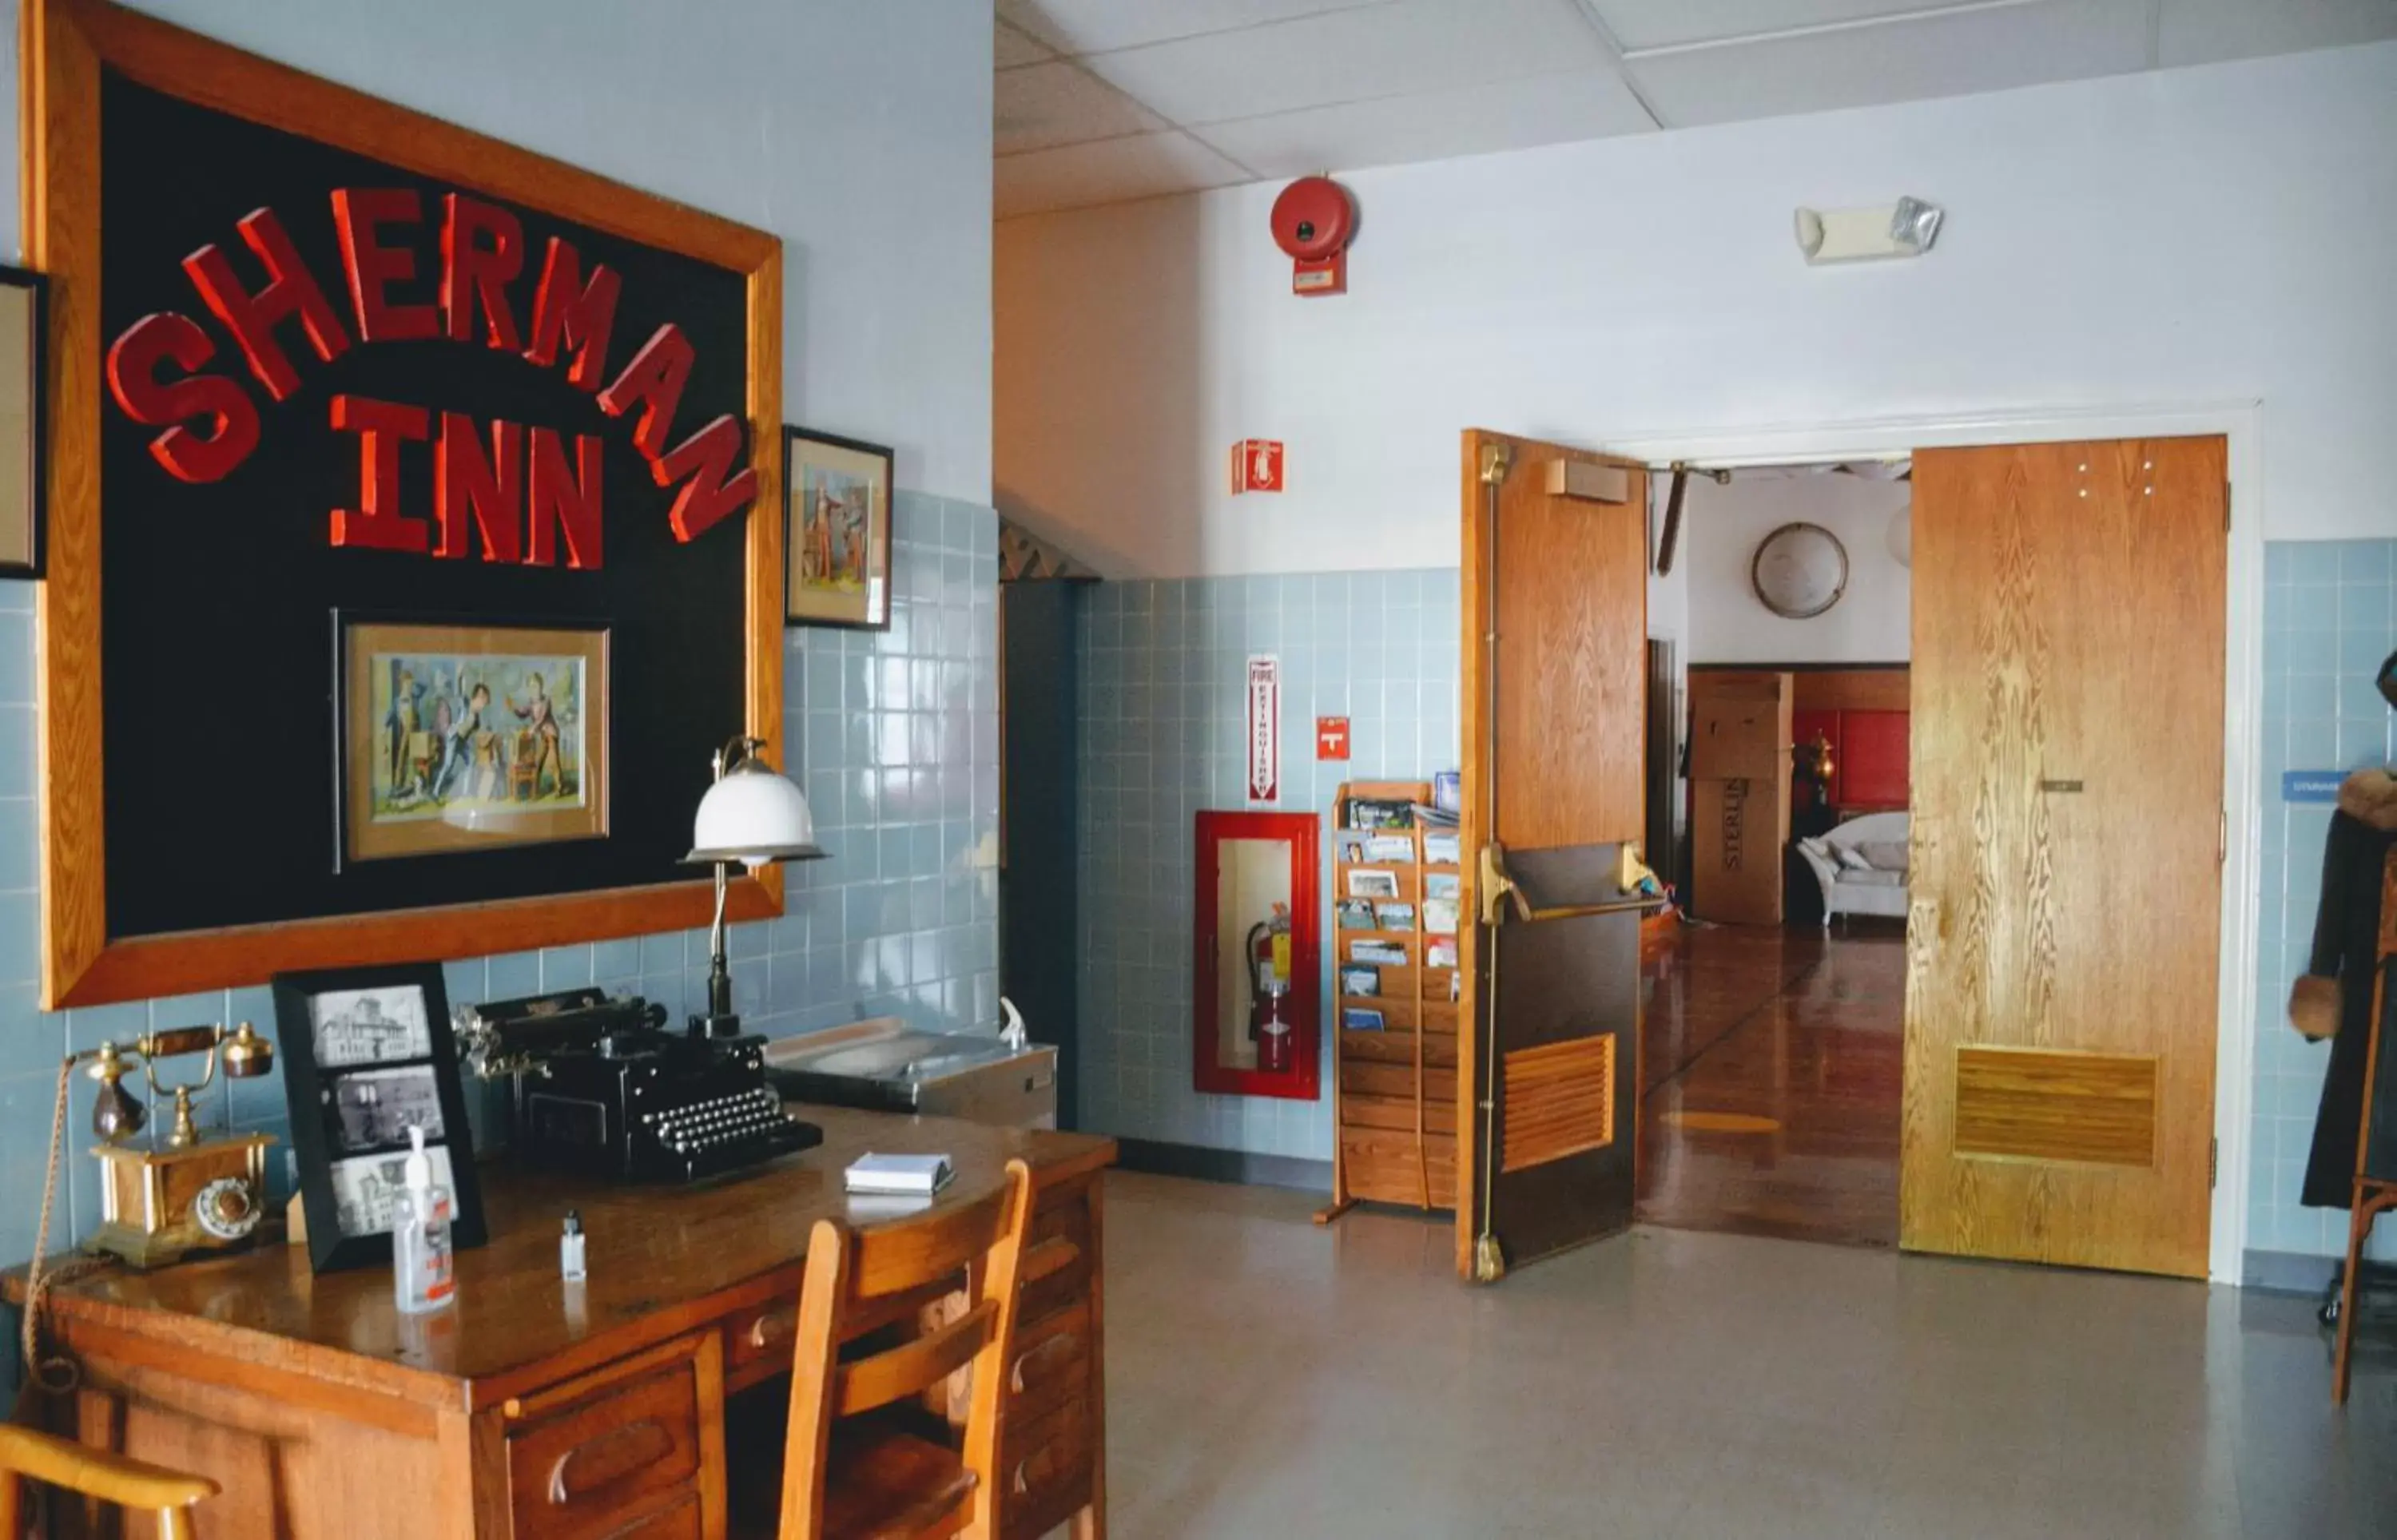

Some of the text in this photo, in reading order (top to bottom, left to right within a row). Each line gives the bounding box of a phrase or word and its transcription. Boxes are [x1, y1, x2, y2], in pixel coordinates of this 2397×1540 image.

[107, 188, 758, 543] SHERMAN
[331, 395, 603, 570] INN
[1251, 669, 1274, 682] FIRE
[1258, 685, 1268, 792] EXTINGUISHER
